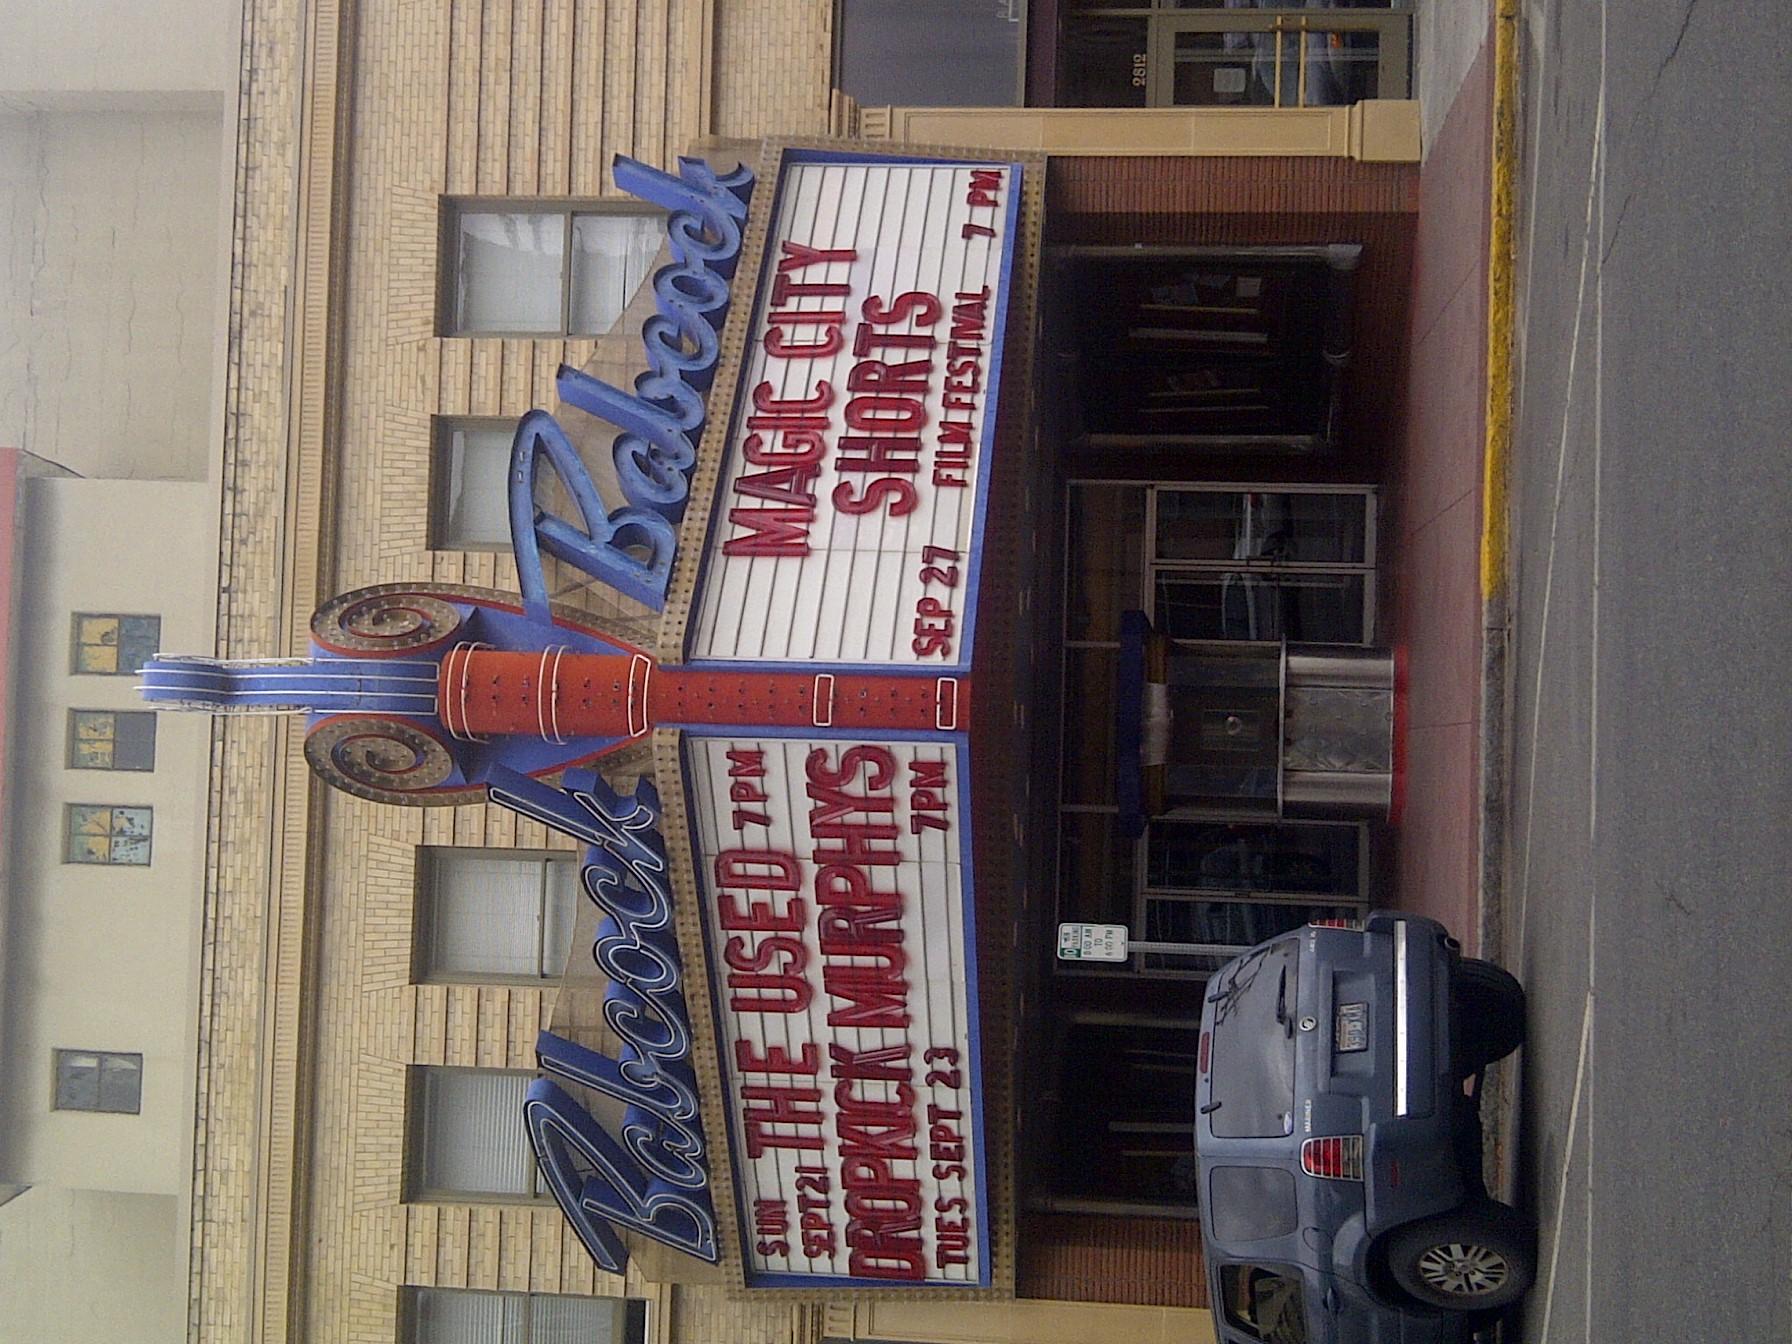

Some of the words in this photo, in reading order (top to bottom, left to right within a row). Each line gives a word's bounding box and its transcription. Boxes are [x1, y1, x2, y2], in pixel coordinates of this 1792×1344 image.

[1132, 53, 1146, 87] 2812
[961, 223, 996, 240] 7
[966, 170, 1002, 208] PM
[763, 239, 858, 359] CITY
[508, 153, 754, 624] Babcock
[941, 285, 991, 412] FESTIVAL
[831, 290, 943, 517] SHORTS
[722, 379, 834, 557] MAGIC
[932, 420, 975, 488] FILM
[919, 545, 961, 588] 27
[912, 596, 955, 657] SEP
[713, 849, 812, 1013] USED
[805, 745, 911, 1029] MURPHYS
[485, 767, 718, 1274] Babcock
[923, 1046, 960, 1089] 23
[734, 1040, 824, 1159] THE
[926, 1104, 967, 1182] SEPT
[827, 1042, 926, 1281] DROPKICK
[753, 1199, 789, 1258] SUN
[934, 1196, 970, 1268] TUES
